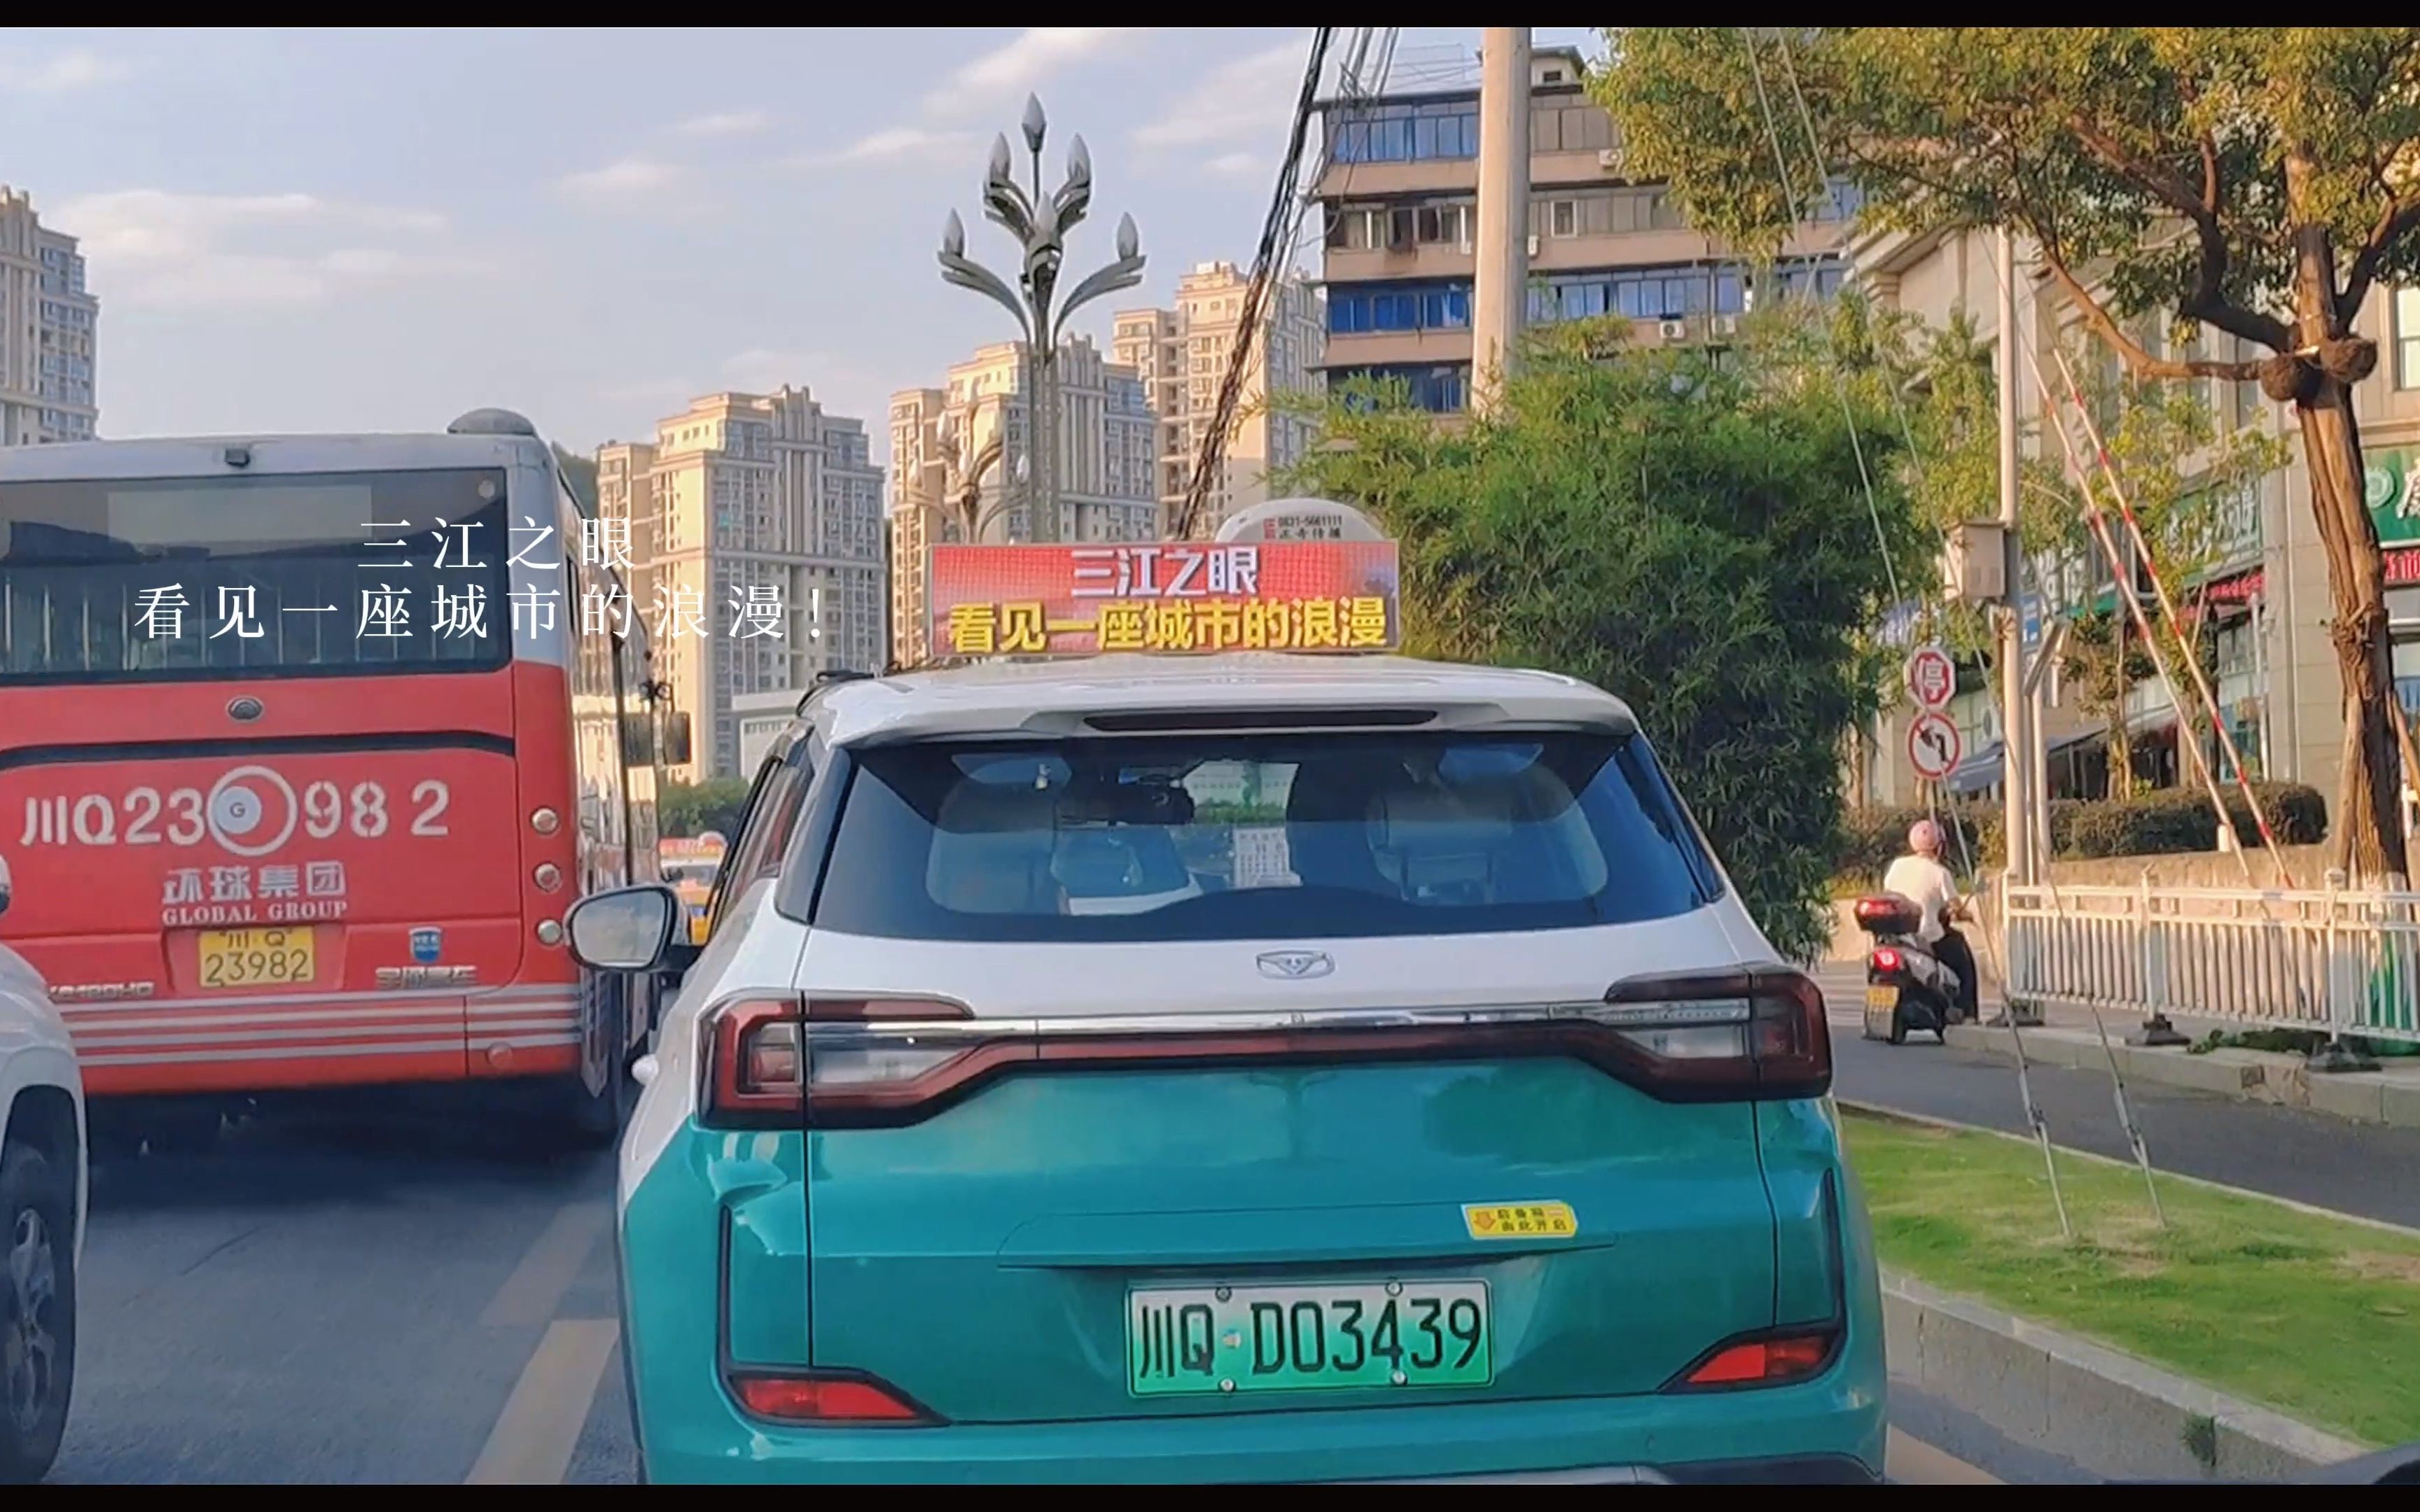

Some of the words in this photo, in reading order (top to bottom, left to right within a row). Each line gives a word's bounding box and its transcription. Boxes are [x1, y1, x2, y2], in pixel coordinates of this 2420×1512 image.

[1071, 546, 1258, 596] 三江之眼
[950, 596, 1387, 652] 看见一座城市的浪漫
[162, 860, 347, 905] 环球集团
[162, 906, 258, 926] GLOBAL
[267, 901, 347, 921] GROUP
[204, 948, 309, 983] 23982
